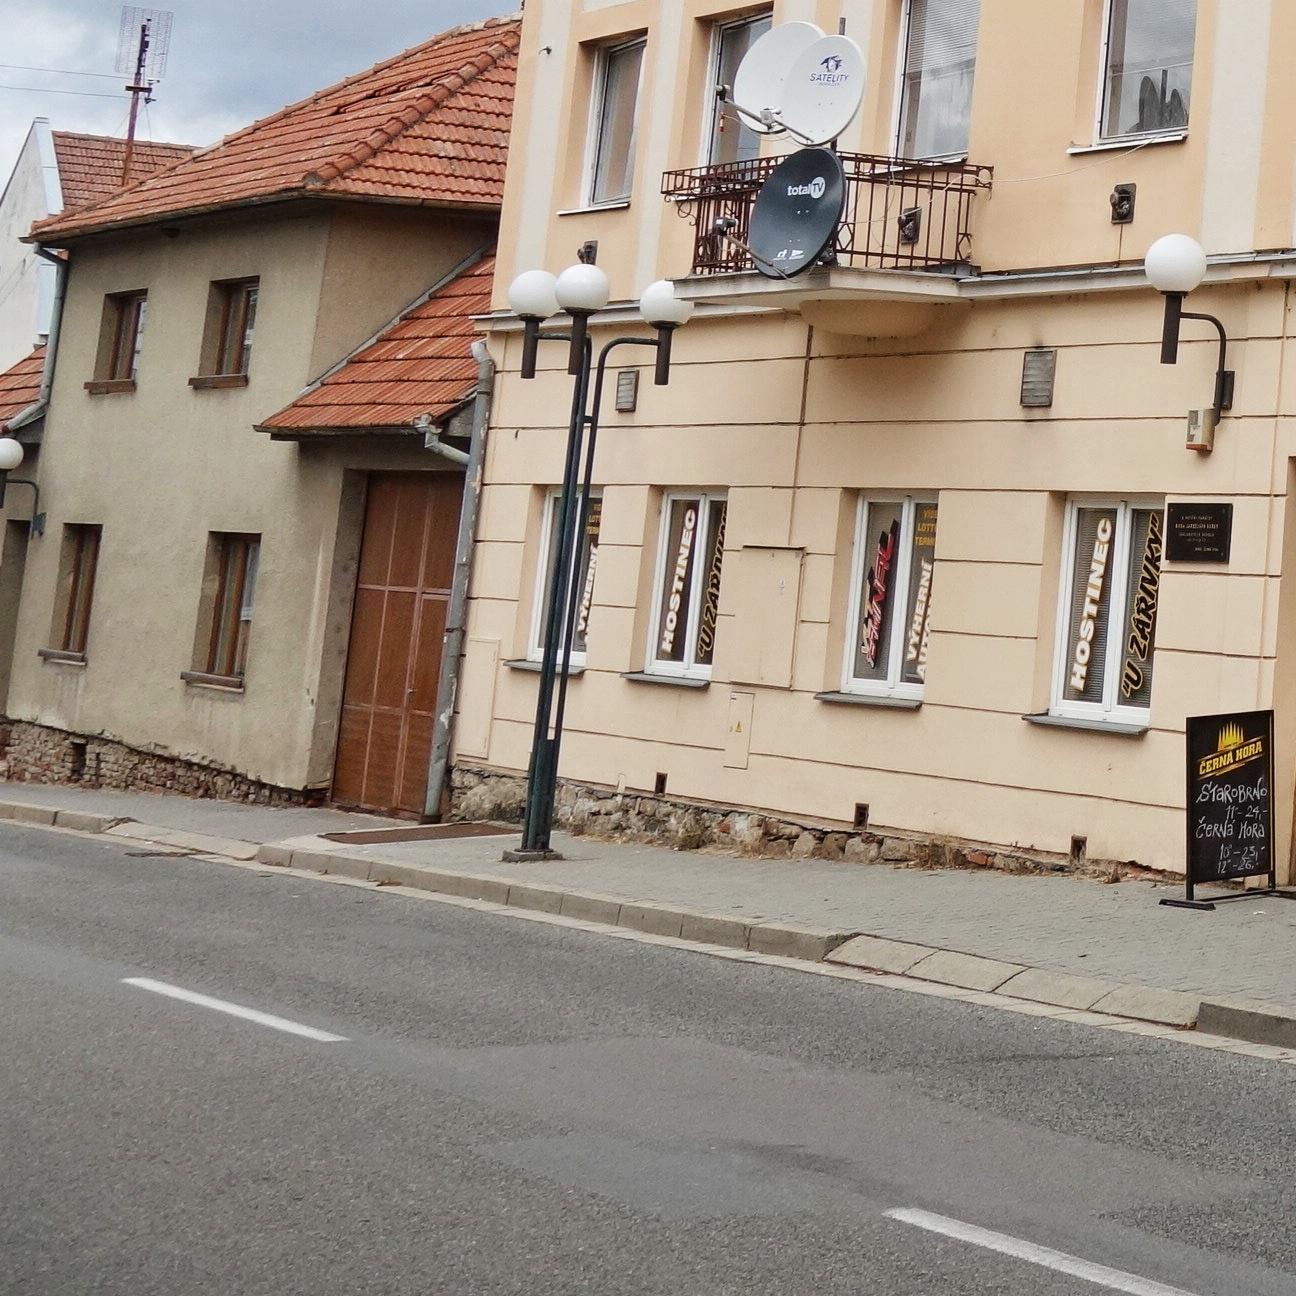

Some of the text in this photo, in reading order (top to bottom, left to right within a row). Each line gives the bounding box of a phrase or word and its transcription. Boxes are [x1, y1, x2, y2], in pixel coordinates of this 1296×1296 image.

[661, 508, 696, 654] HOSTINEC
[1070, 517, 1113, 692] HOSTINEC
[1199, 741, 1263, 776] ČERNÁ HORA
